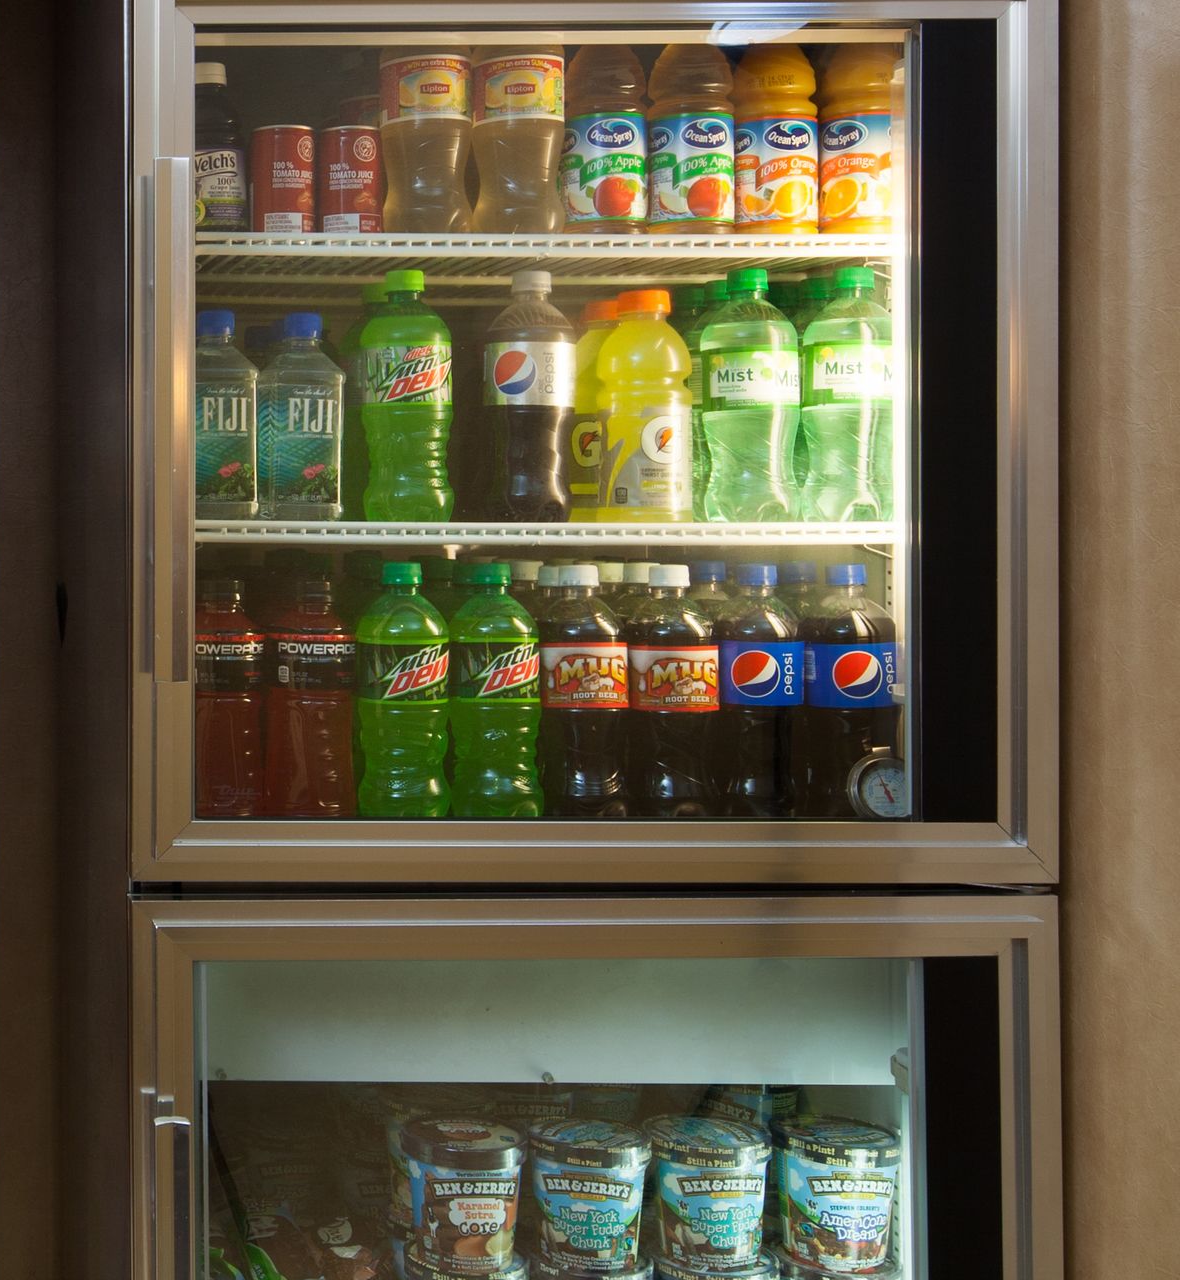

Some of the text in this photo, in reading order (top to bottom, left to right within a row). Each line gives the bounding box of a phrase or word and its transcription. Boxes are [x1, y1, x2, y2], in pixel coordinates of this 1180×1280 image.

[422, 84, 448, 93] Lipton
[506, 84, 534, 93] Lipton
[590, 129, 633, 144] Ocean Spray
[685, 129, 727, 144] Ocean Spray
[769, 130, 809, 146] Ocean Spray
[838, 131, 859, 146] Spray
[587, 156, 642, 174] 100% Apple
[681, 157, 732, 174] 100% Apple
[760, 158, 788, 178] 100%
[837, 157, 875, 169] Orange
[357, 171, 374, 179] JUICE
[543, 351, 555, 395] pepsi
[717, 369, 754, 383] Mist
[824, 361, 863, 376] Mist
[202, 396, 251, 433] FIJI
[287, 397, 337, 435] FIJI
[278, 642, 356, 655] POWERADE
[559, 656, 627, 686] MUG
[652, 659, 717, 688] MUG
[782, 652, 795, 695] pepsi
[883, 651, 896, 695] pepsi
[572, 691, 618, 700] ROOT BEER
[691, 695, 710, 703] BEER
[812, 1144, 835, 1156] Pint!
[687, 1157, 736, 1168] Still Pint!
[456, 1201, 501, 1211] Karamel
[699, 1205, 754, 1221] New York
[561, 1208, 618, 1223] New York
[459, 1221, 499, 1236] Core
[553, 1218, 626, 1237] Super Fudge
[691, 1220, 730, 1235] Super
[835, 1226, 879, 1241] Dream
[569, 1234, 612, 1249] Chunk
[710, 1232, 749, 1247] Chunk
